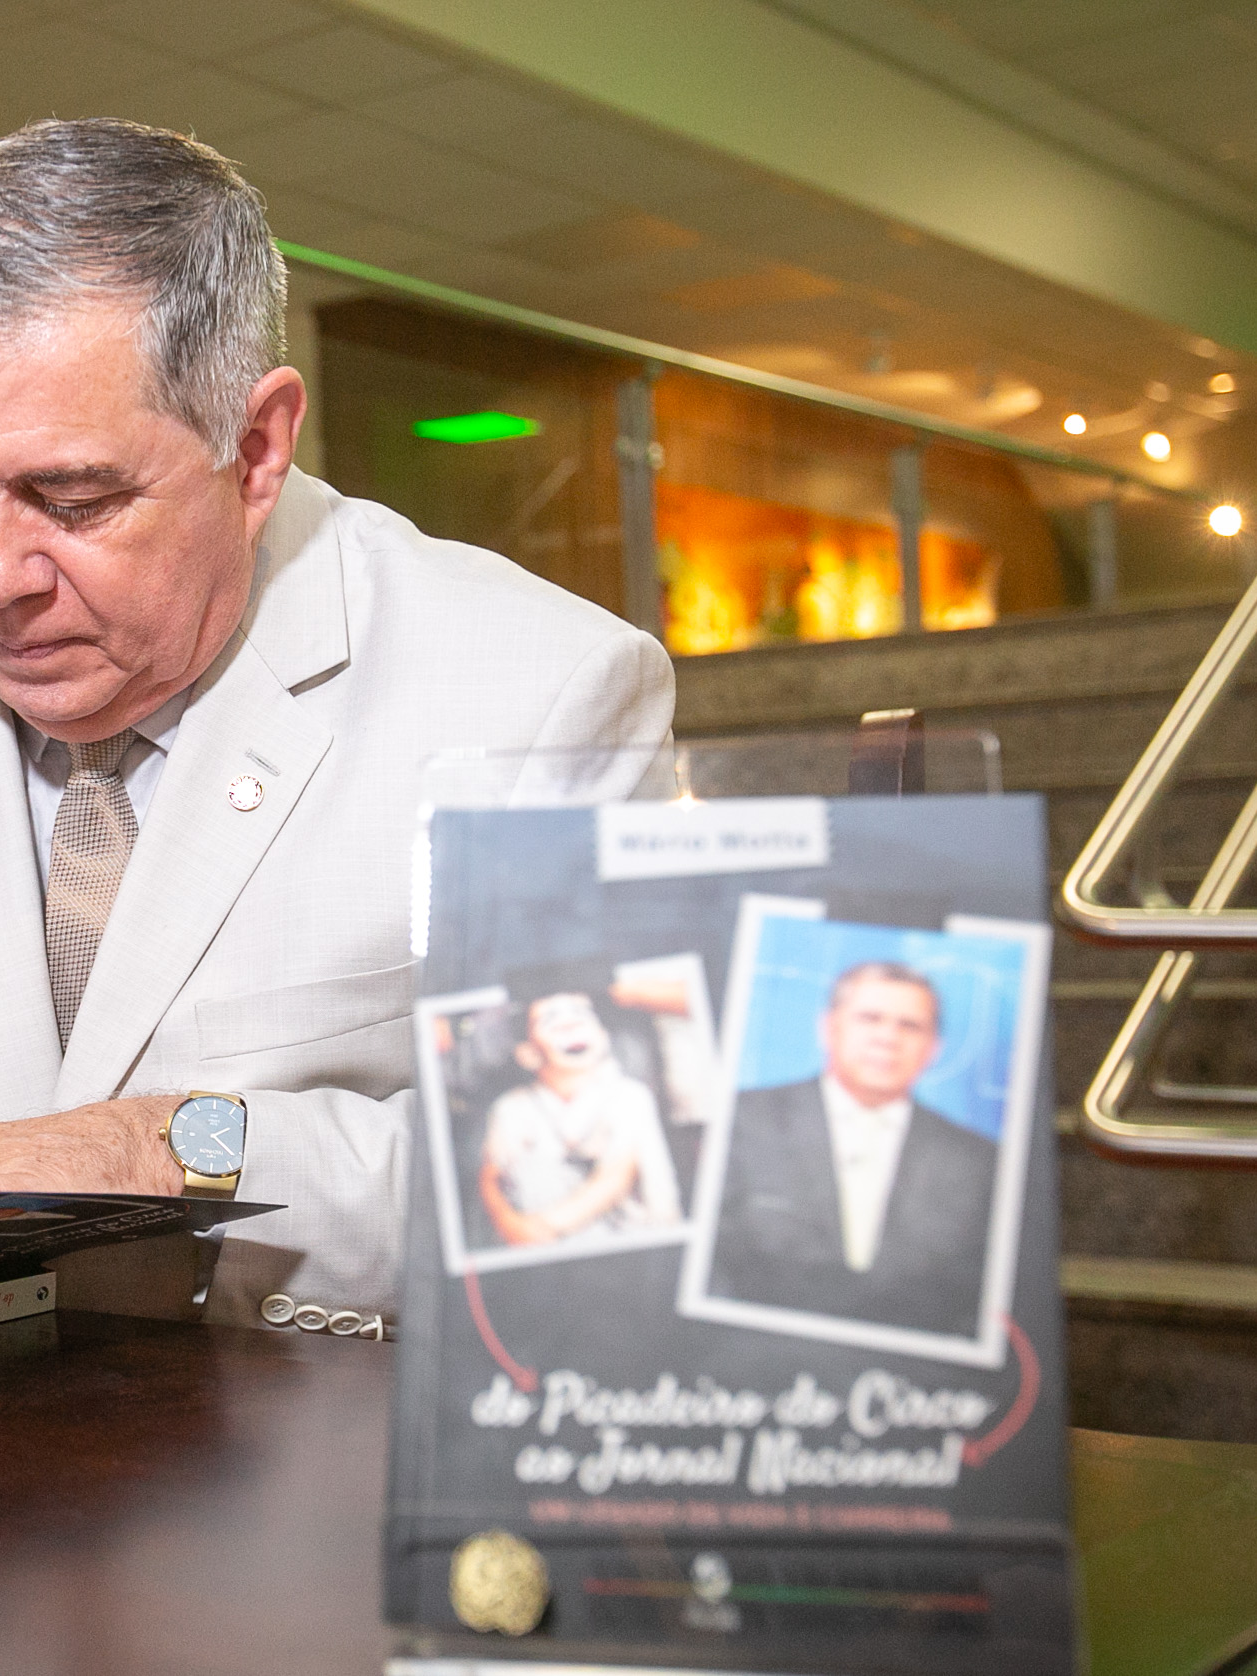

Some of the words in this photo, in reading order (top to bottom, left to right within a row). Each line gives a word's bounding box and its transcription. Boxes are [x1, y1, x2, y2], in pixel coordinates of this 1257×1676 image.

[3, 1293, 15, 1308] do
[539, 1368, 768, 1436] Picadeiro
[773, 1371, 841, 1429] do
[847, 1367, 993, 1439] Circo
[514, 1444, 574, 1490] ao
[577, 1427, 743, 1496] Jornal
[746, 1427, 965, 1497] Nacional
